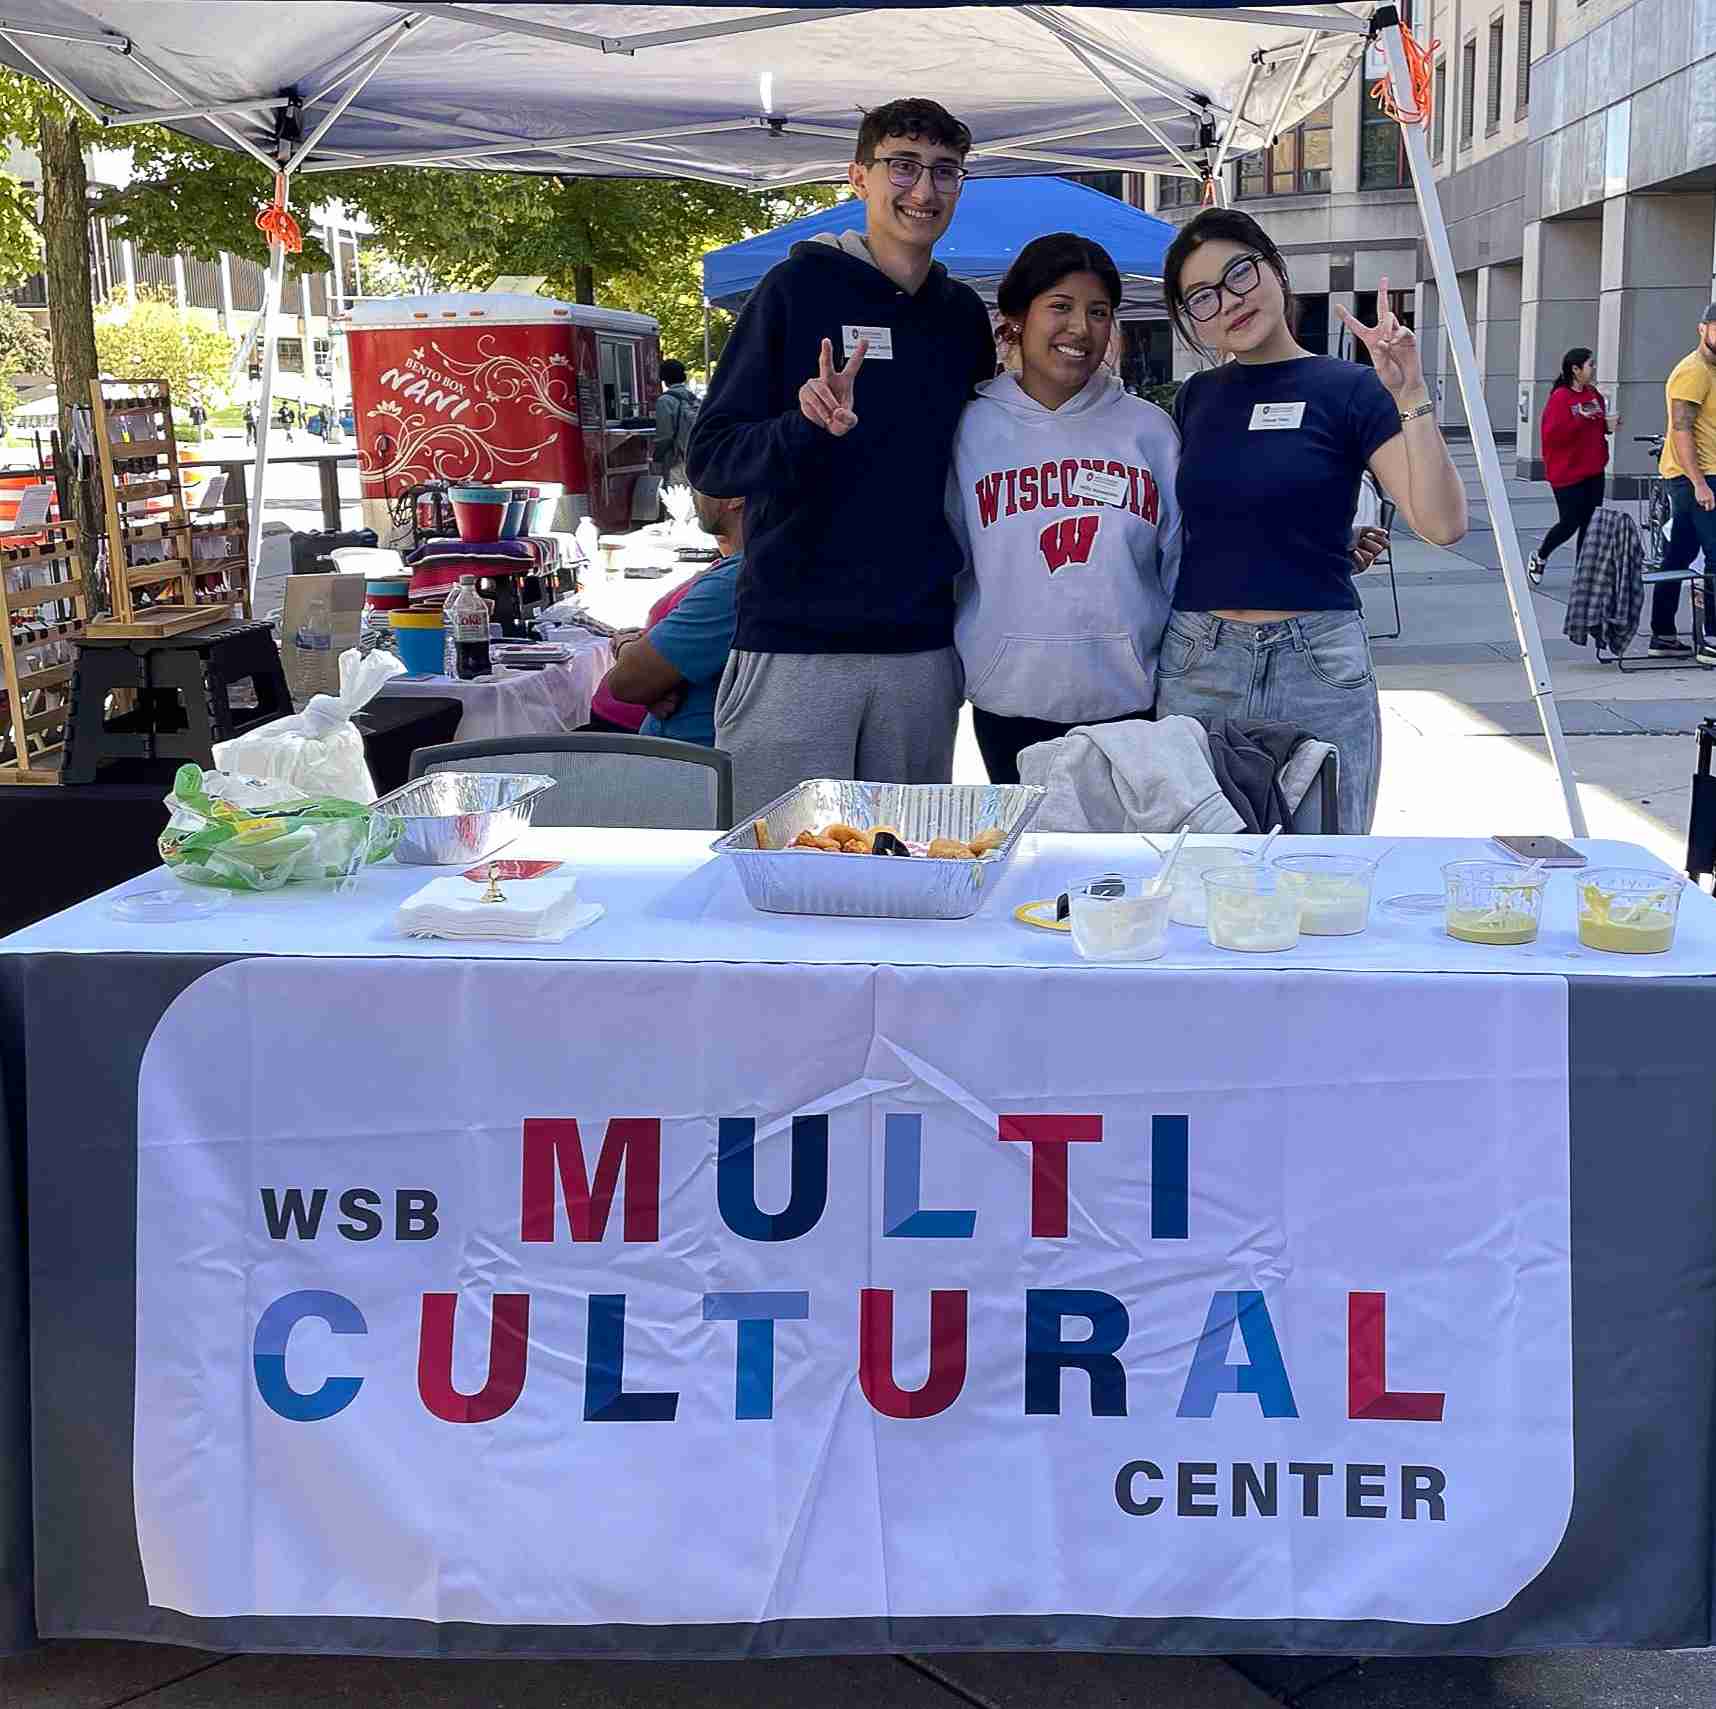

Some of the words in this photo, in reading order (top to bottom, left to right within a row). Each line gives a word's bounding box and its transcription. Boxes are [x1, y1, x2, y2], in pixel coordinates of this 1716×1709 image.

[380, 367, 471, 419] NANI
[404, 357, 441, 382] BENTO
[442, 376, 466, 396] BOX
[1040, 516, 1100, 574] W
[261, 1188, 440, 1242] WSB
[521, 1113, 1189, 1243] MULTI
[253, 1288, 1446, 1424] CULTURAL
[1114, 1460, 1446, 1522] CENTER
